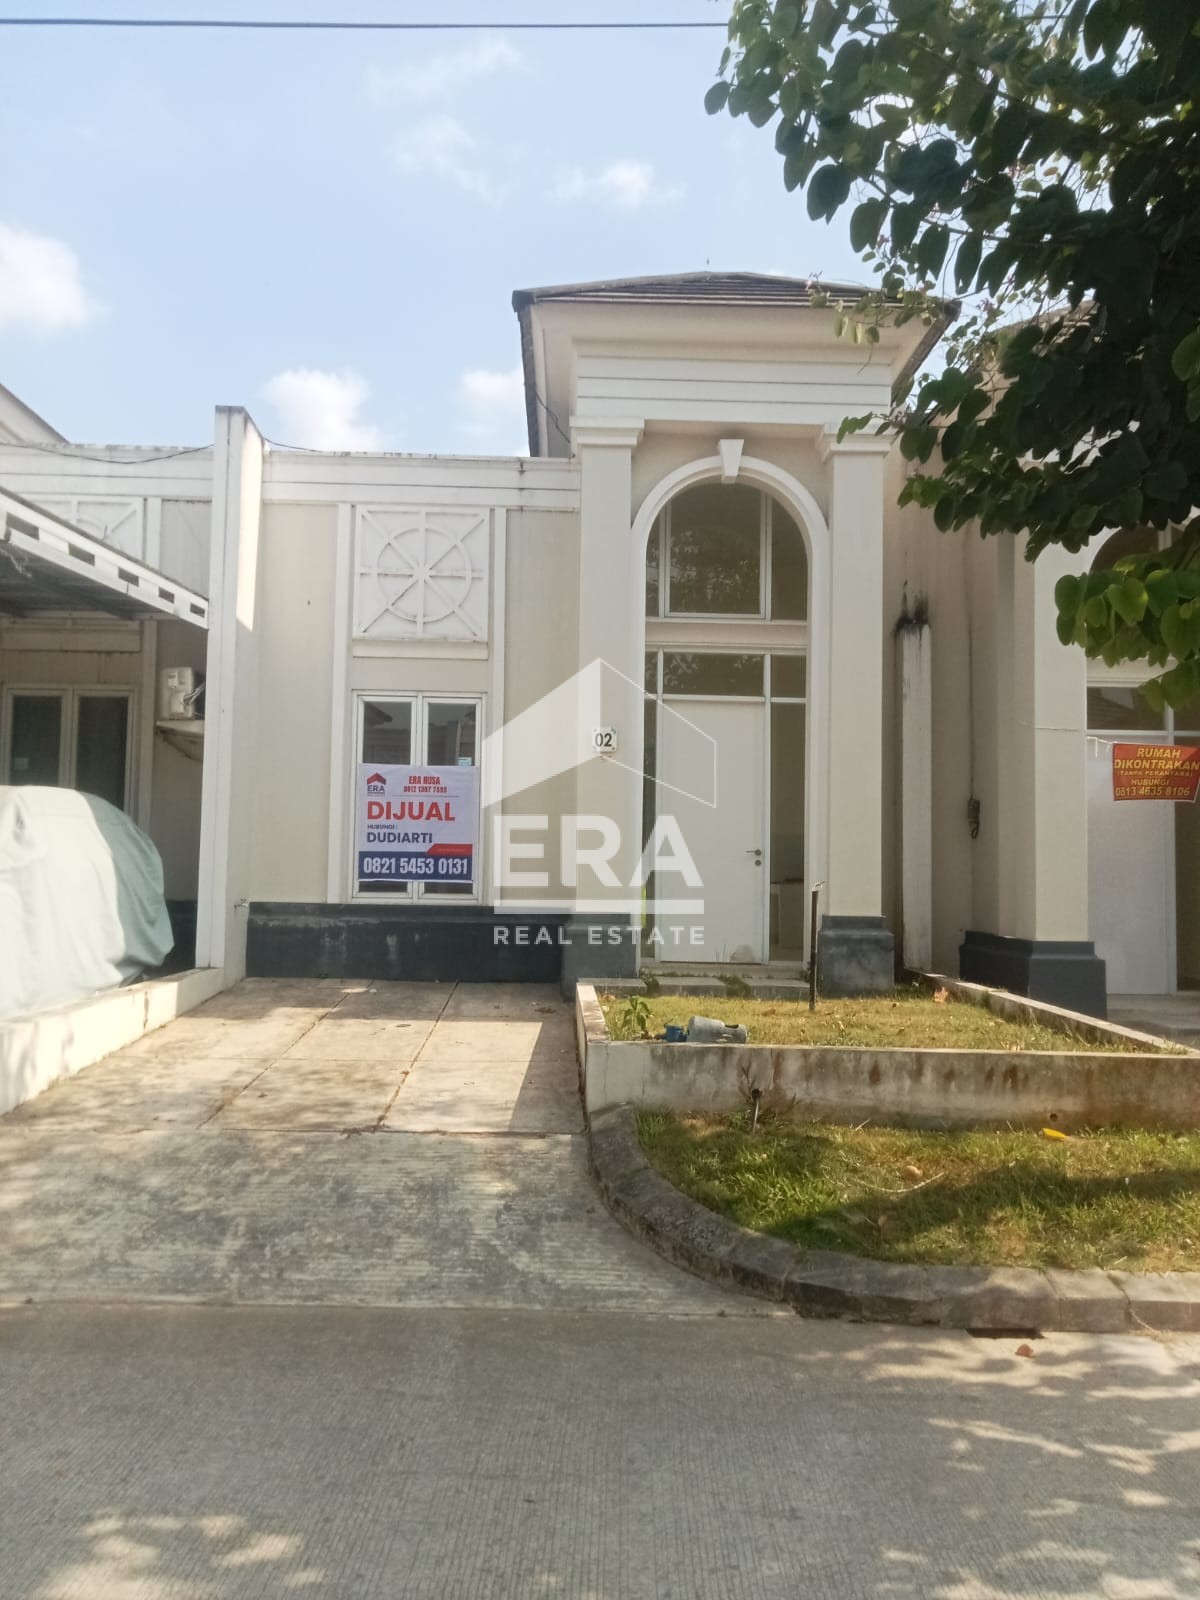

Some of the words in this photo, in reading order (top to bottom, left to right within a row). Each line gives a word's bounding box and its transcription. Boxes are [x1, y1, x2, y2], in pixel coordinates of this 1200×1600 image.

[595, 732, 613, 748] 02
[1136, 747, 1181, 758] RUMAH
[1114, 759, 1200, 770] DIKONTRAKAN
[409, 776, 422, 784] ERA
[368, 801, 456, 820] DIJUAL
[367, 832, 433, 843] DUDIARTI
[363, 857, 397, 874] 0821
[399, 857, 435, 875] 5453
[438, 857, 468, 875] 0131
